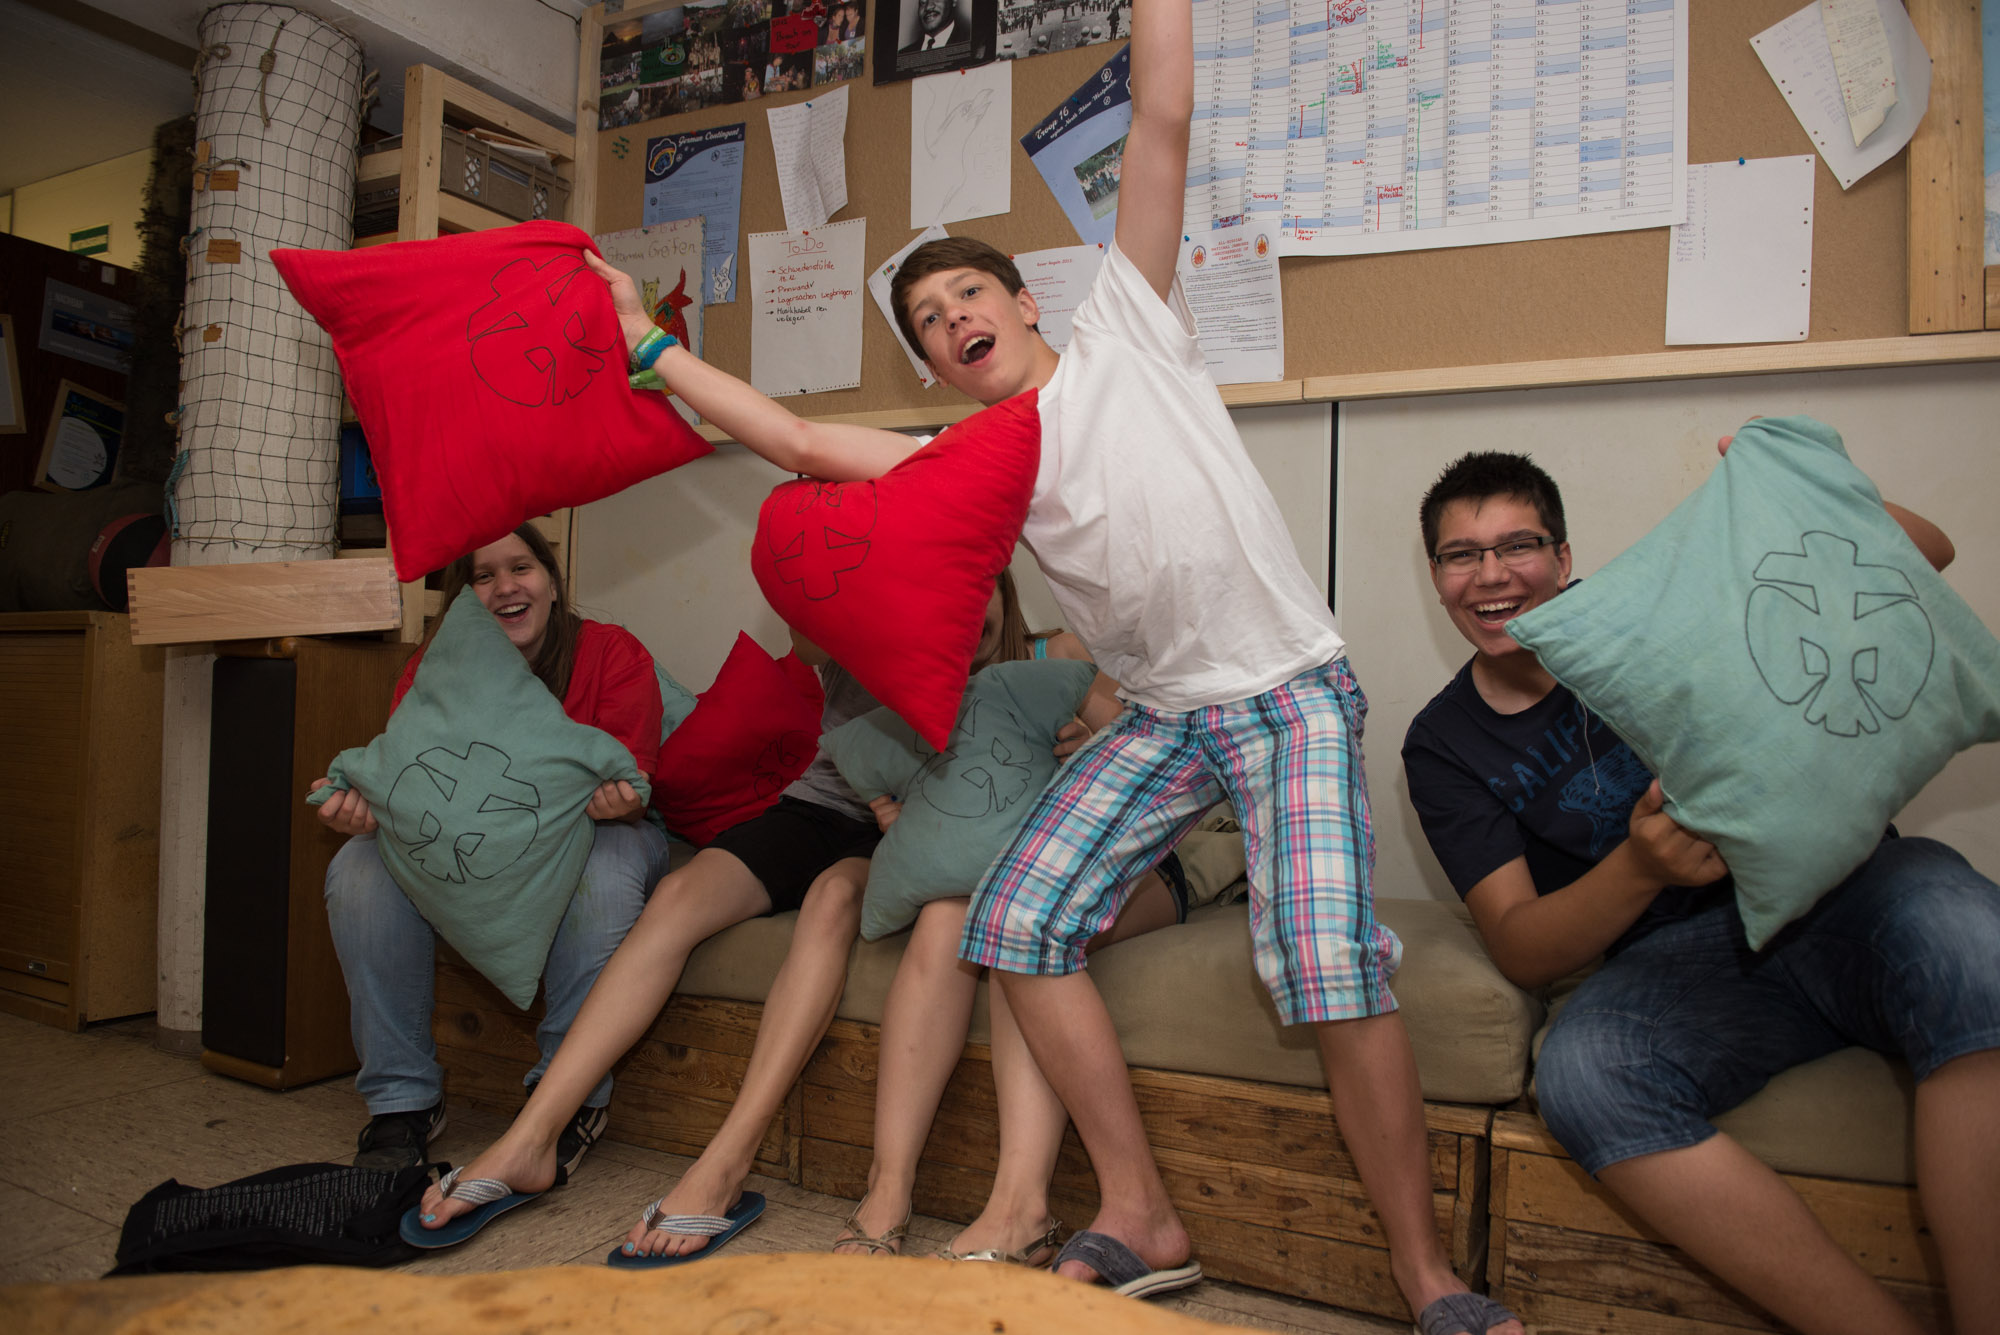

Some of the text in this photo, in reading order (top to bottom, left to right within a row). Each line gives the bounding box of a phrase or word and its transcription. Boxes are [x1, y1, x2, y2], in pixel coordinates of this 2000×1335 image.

[1035, 106, 1069, 140] Troop 16
[679, 128, 739, 147] German Contingent
